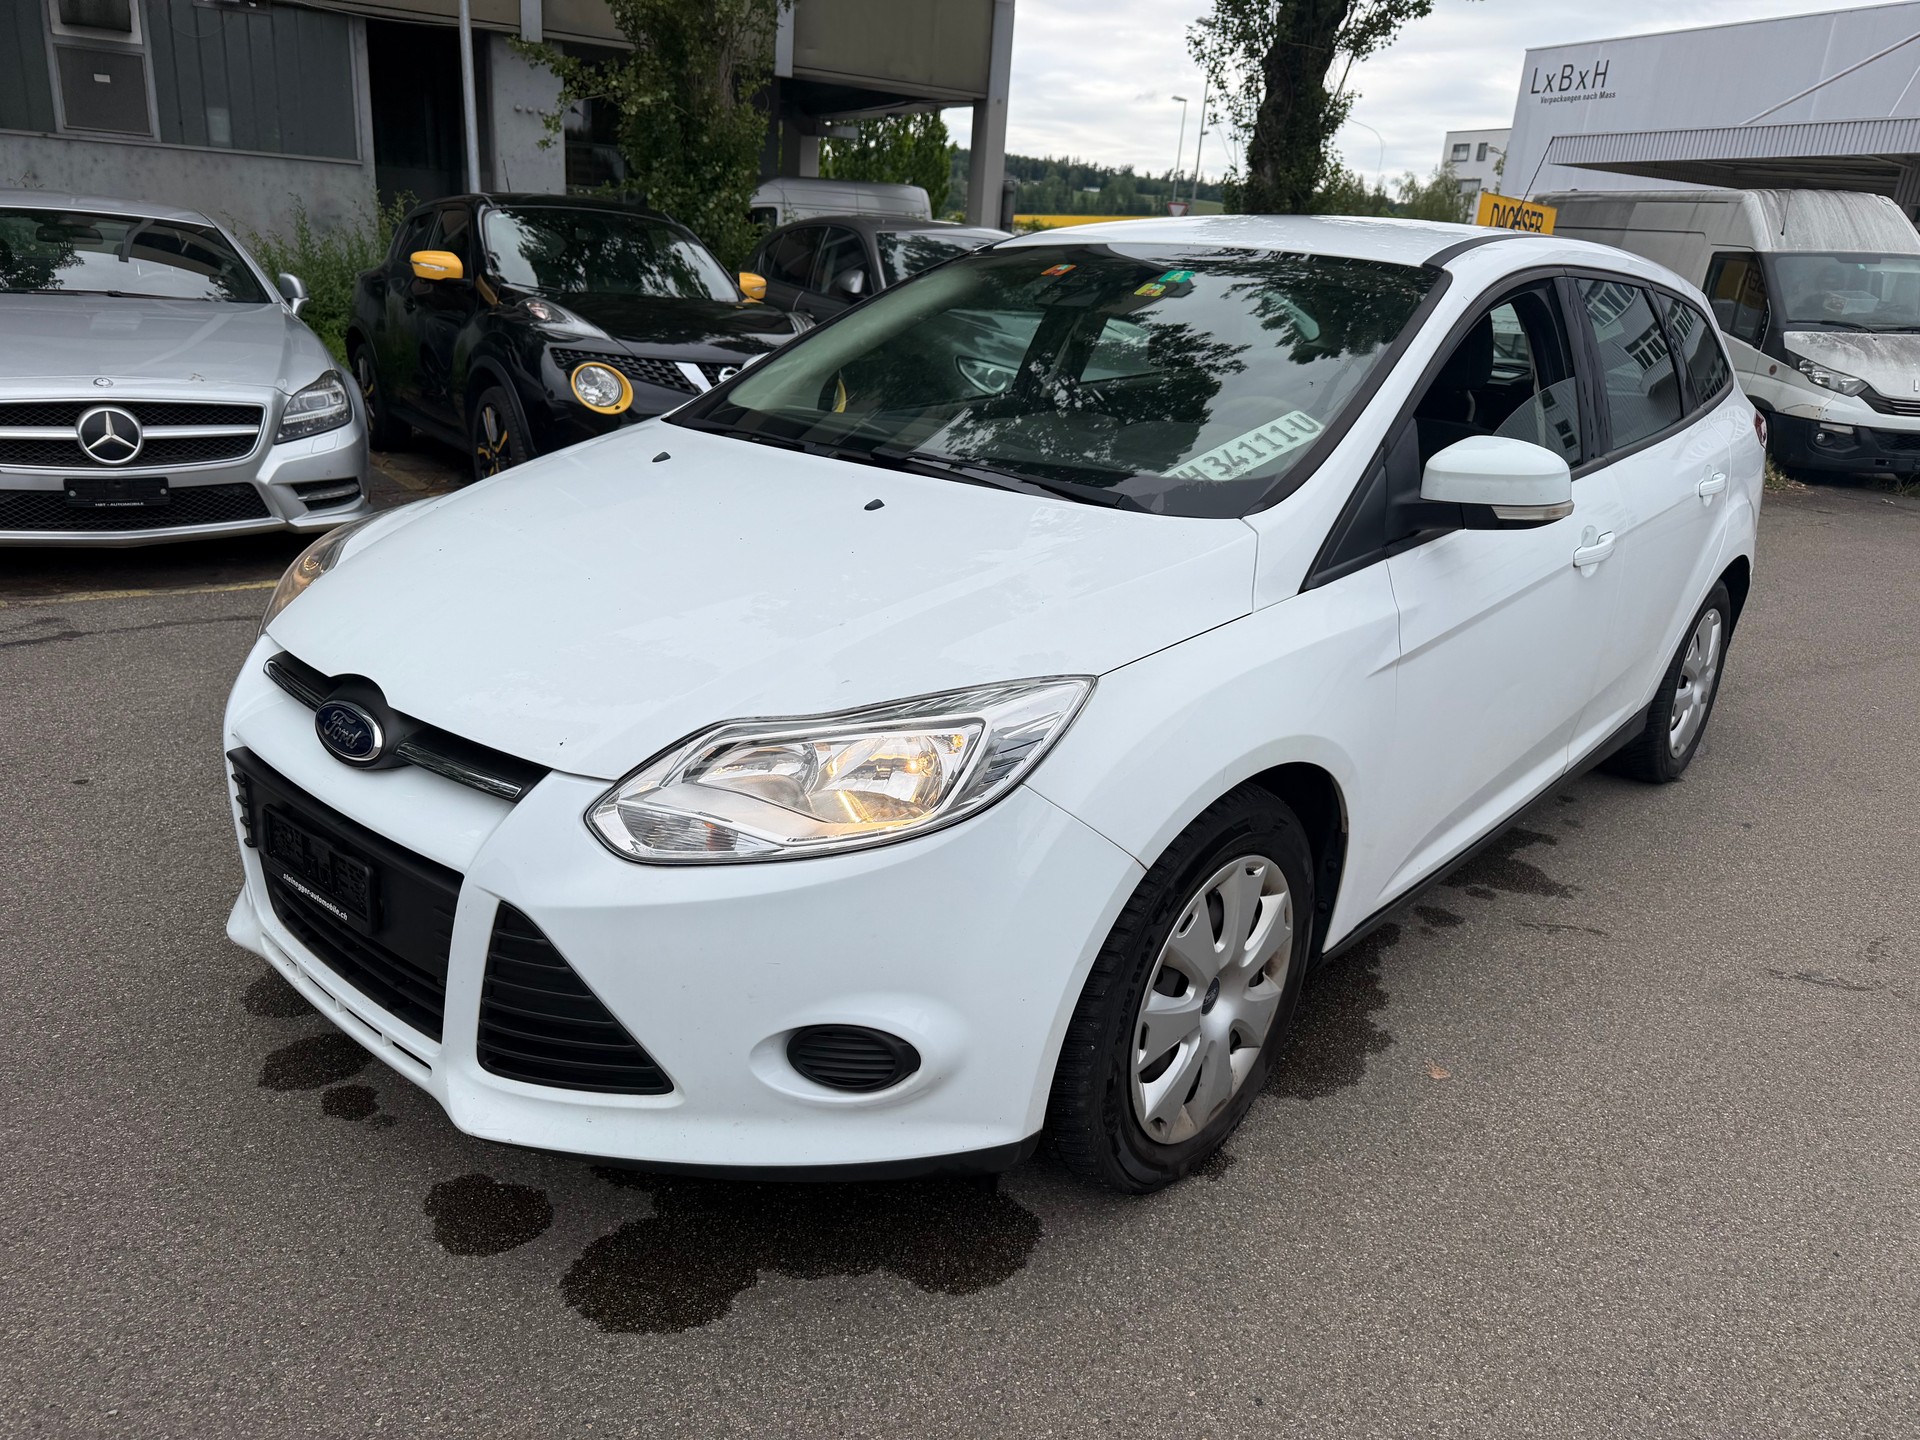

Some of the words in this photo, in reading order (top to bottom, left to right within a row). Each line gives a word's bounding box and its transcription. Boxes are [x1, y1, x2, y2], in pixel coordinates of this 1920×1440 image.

[1531, 60, 1609, 94] LxBxH
[1541, 94, 1581, 105] Verpackungen
[1582, 92, 1598, 101] nach
[1599, 91, 1616, 100] Mass
[1489, 203, 1544, 232] DACHSER
[324, 710, 361, 749] Ford
